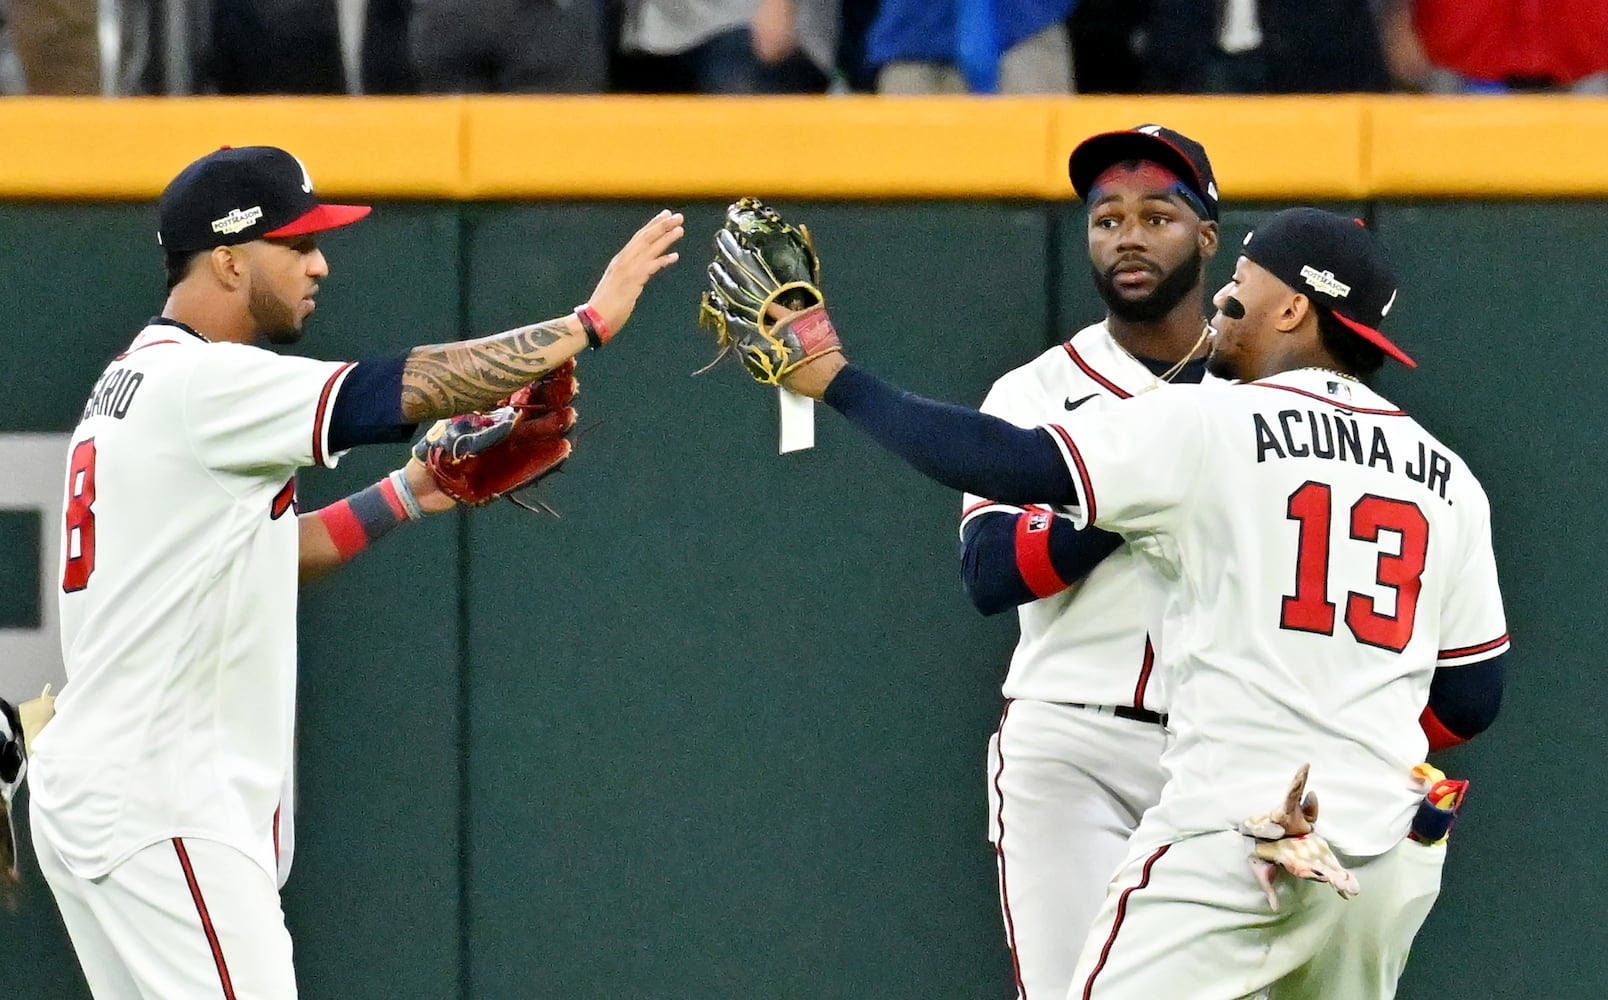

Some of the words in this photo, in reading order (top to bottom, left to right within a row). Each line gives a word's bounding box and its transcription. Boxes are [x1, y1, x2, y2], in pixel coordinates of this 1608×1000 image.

[1302, 268, 1347, 293] POSTSEASON
[62, 436, 97, 594] 8
[1252, 408, 1395, 473] ACUÑA
[1405, 440, 1453, 506] JR.
[1279, 479, 1430, 654] 13
